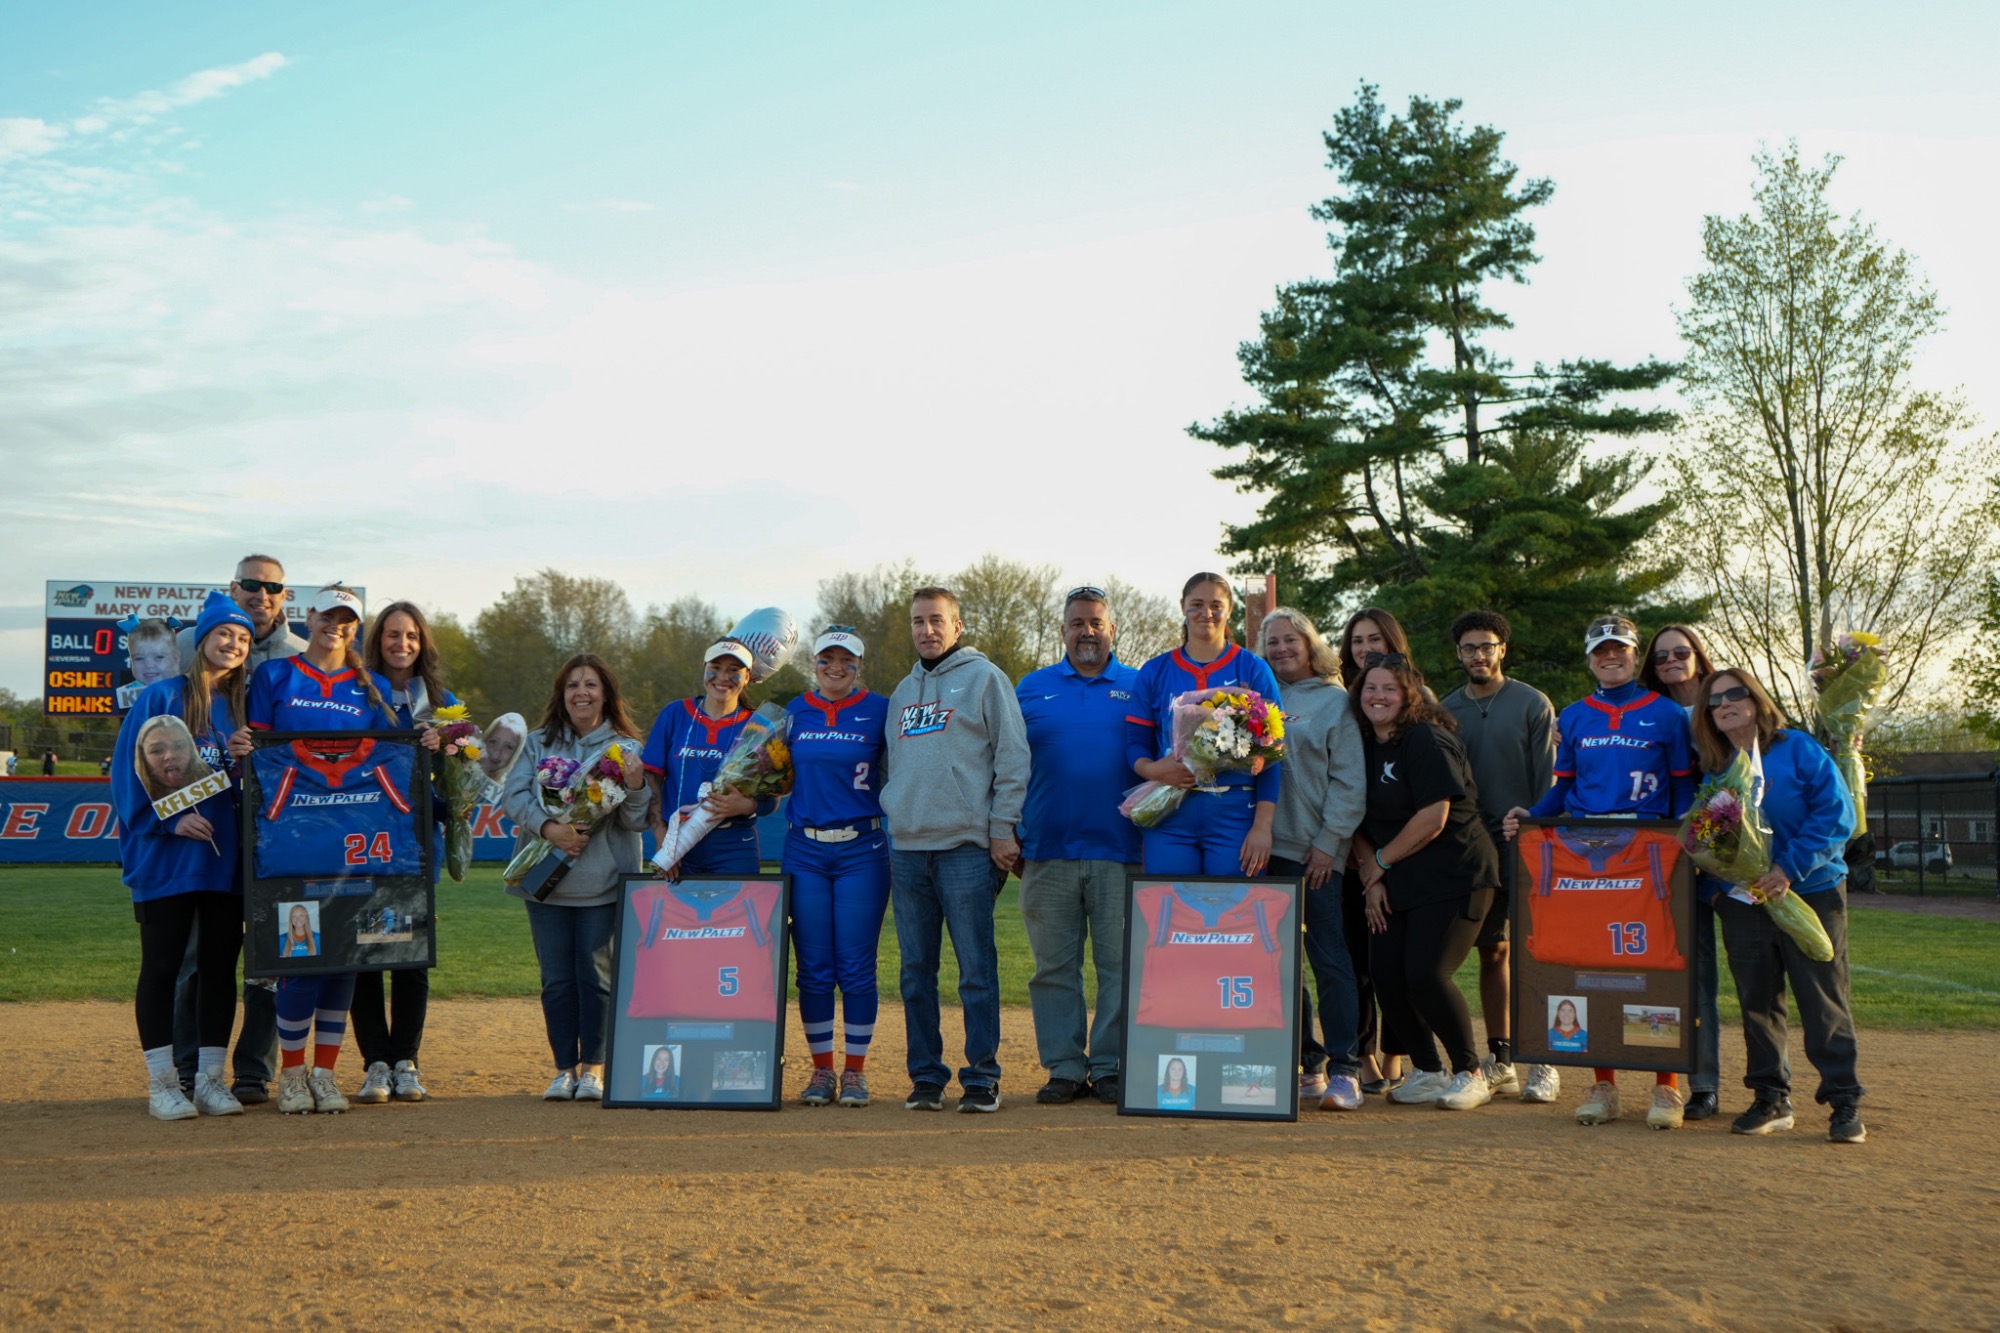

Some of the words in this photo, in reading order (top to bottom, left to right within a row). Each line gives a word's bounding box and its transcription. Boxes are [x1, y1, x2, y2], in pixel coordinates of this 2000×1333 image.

[114, 586, 152, 598] NEW
[157, 587, 206, 600] PALTZ
[95, 603, 142, 616] MARY
[146, 604, 192, 617] GRAY
[51, 634, 93, 650] BALL
[853, 762, 871, 791] 2
[1629, 770, 1659, 802] 13
[344, 832, 393, 866] 24
[1608, 921, 1647, 955] 13
[718, 966, 739, 997] 5
[1217, 976, 1254, 1008] 15
